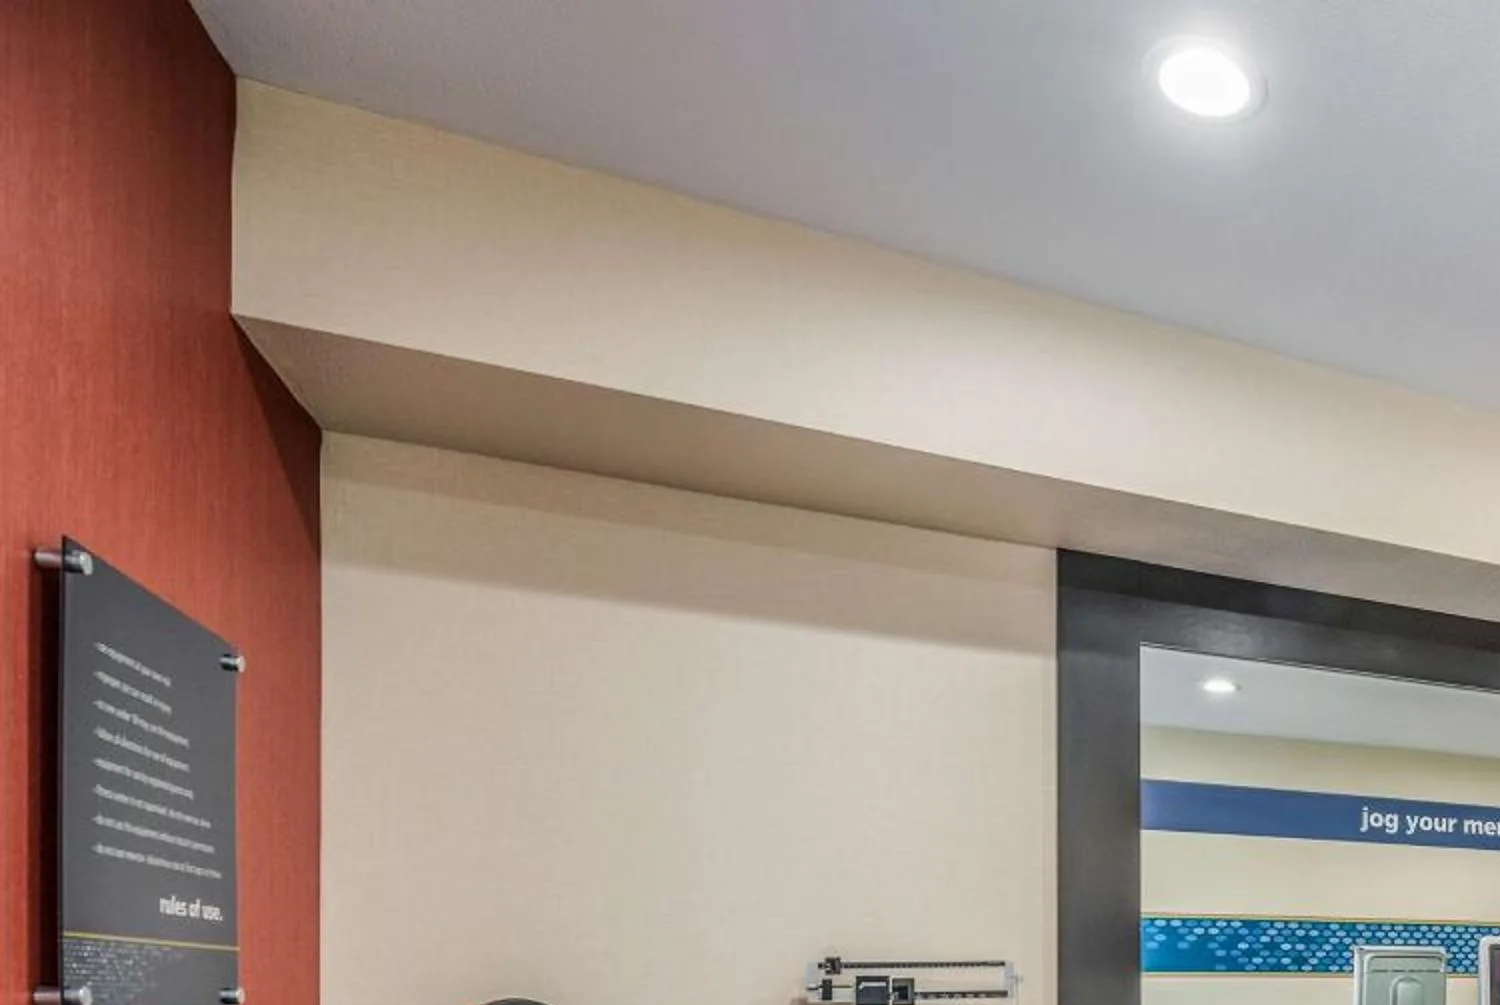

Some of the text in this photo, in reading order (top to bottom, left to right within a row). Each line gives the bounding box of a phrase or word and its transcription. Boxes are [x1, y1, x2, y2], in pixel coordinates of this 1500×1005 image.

[1360, 806, 1399, 834] jog
[1405, 813, 1458, 835] your
[159, 895, 223, 921] rules of use.
